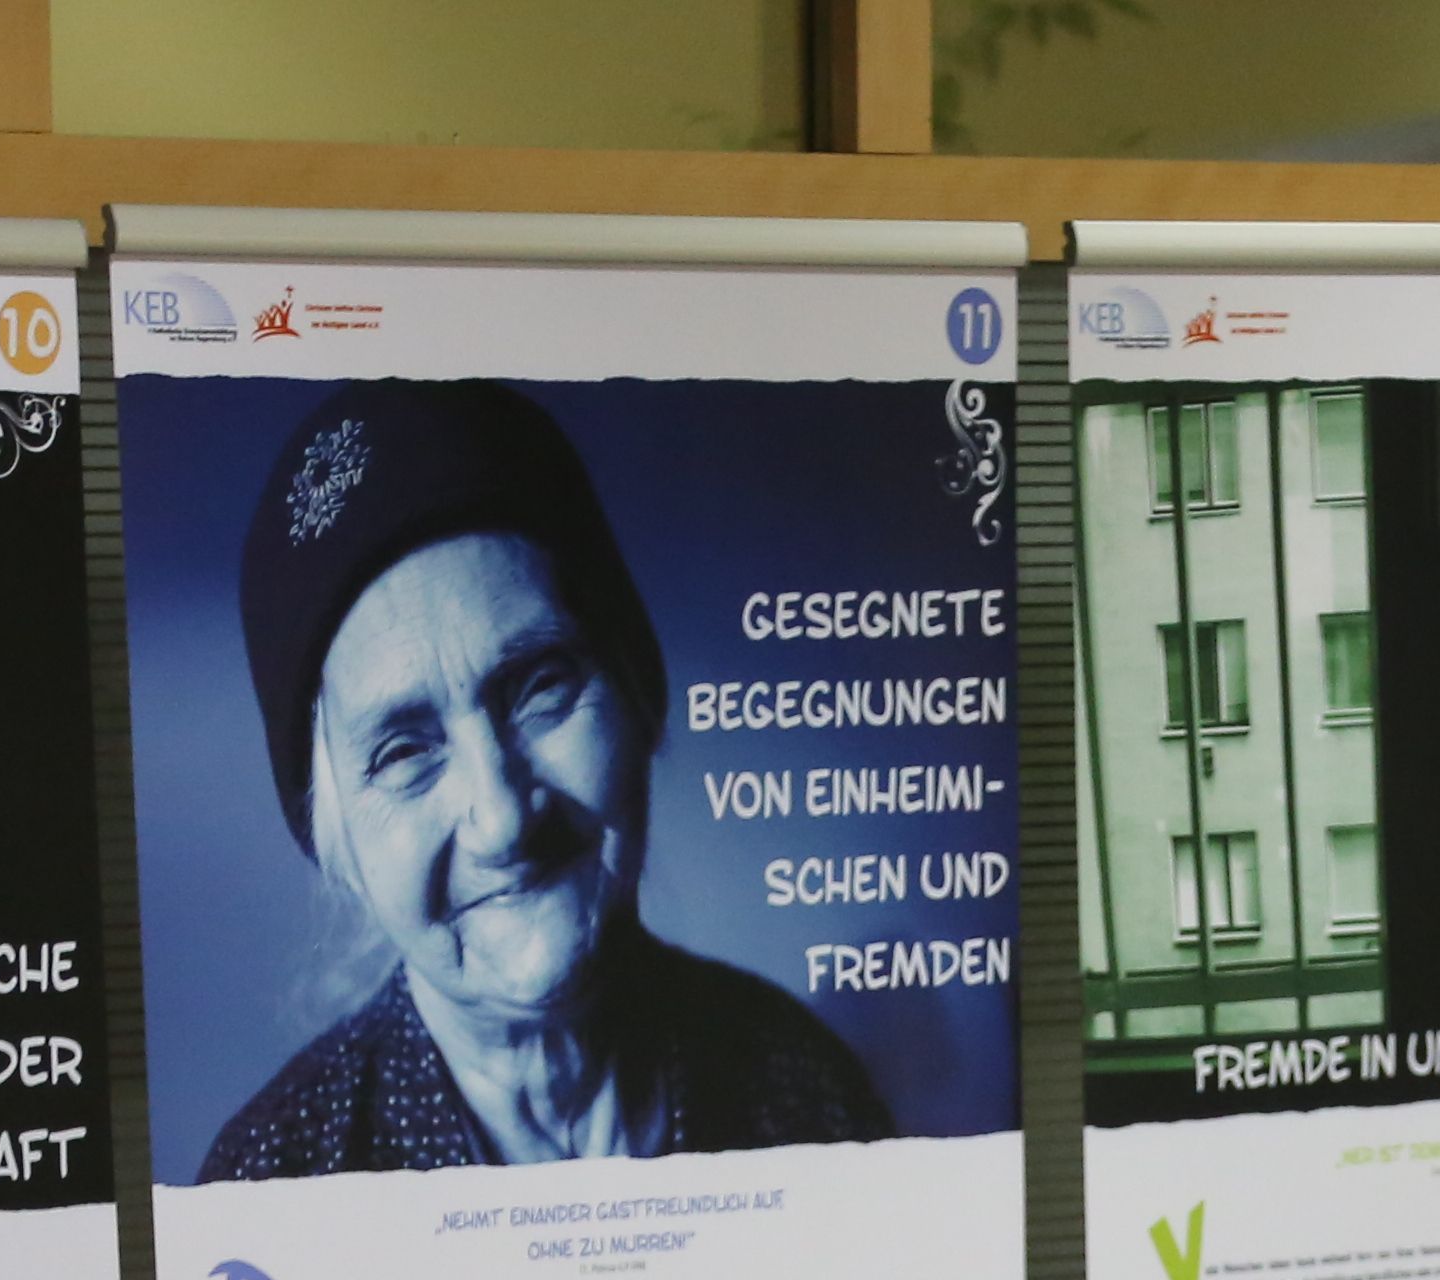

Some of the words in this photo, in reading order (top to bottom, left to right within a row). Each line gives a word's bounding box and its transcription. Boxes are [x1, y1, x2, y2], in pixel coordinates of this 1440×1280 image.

[2, 307, 58, 358] 10
[123, 289, 180, 325] KEB
[960, 302, 991, 350] 11
[1077, 302, 1126, 333] KEB
[742, 589, 1006, 640] GESEGNETE
[687, 677, 1007, 732] BEGEGNUNGEN
[704, 769, 793, 820] VON
[805, 765, 1006, 817] EINHEIMI-
[764, 855, 907, 906] SCHEN
[920, 852, 1010, 899] UND
[805, 937, 1011, 993] FREMDEN
[1194, 1034, 1353, 1093] FREMDE
[1361, 1033, 1397, 1081] IN
[527, 1239, 574, 1260] OHNE
[579, 1238, 605, 1257] ZU
